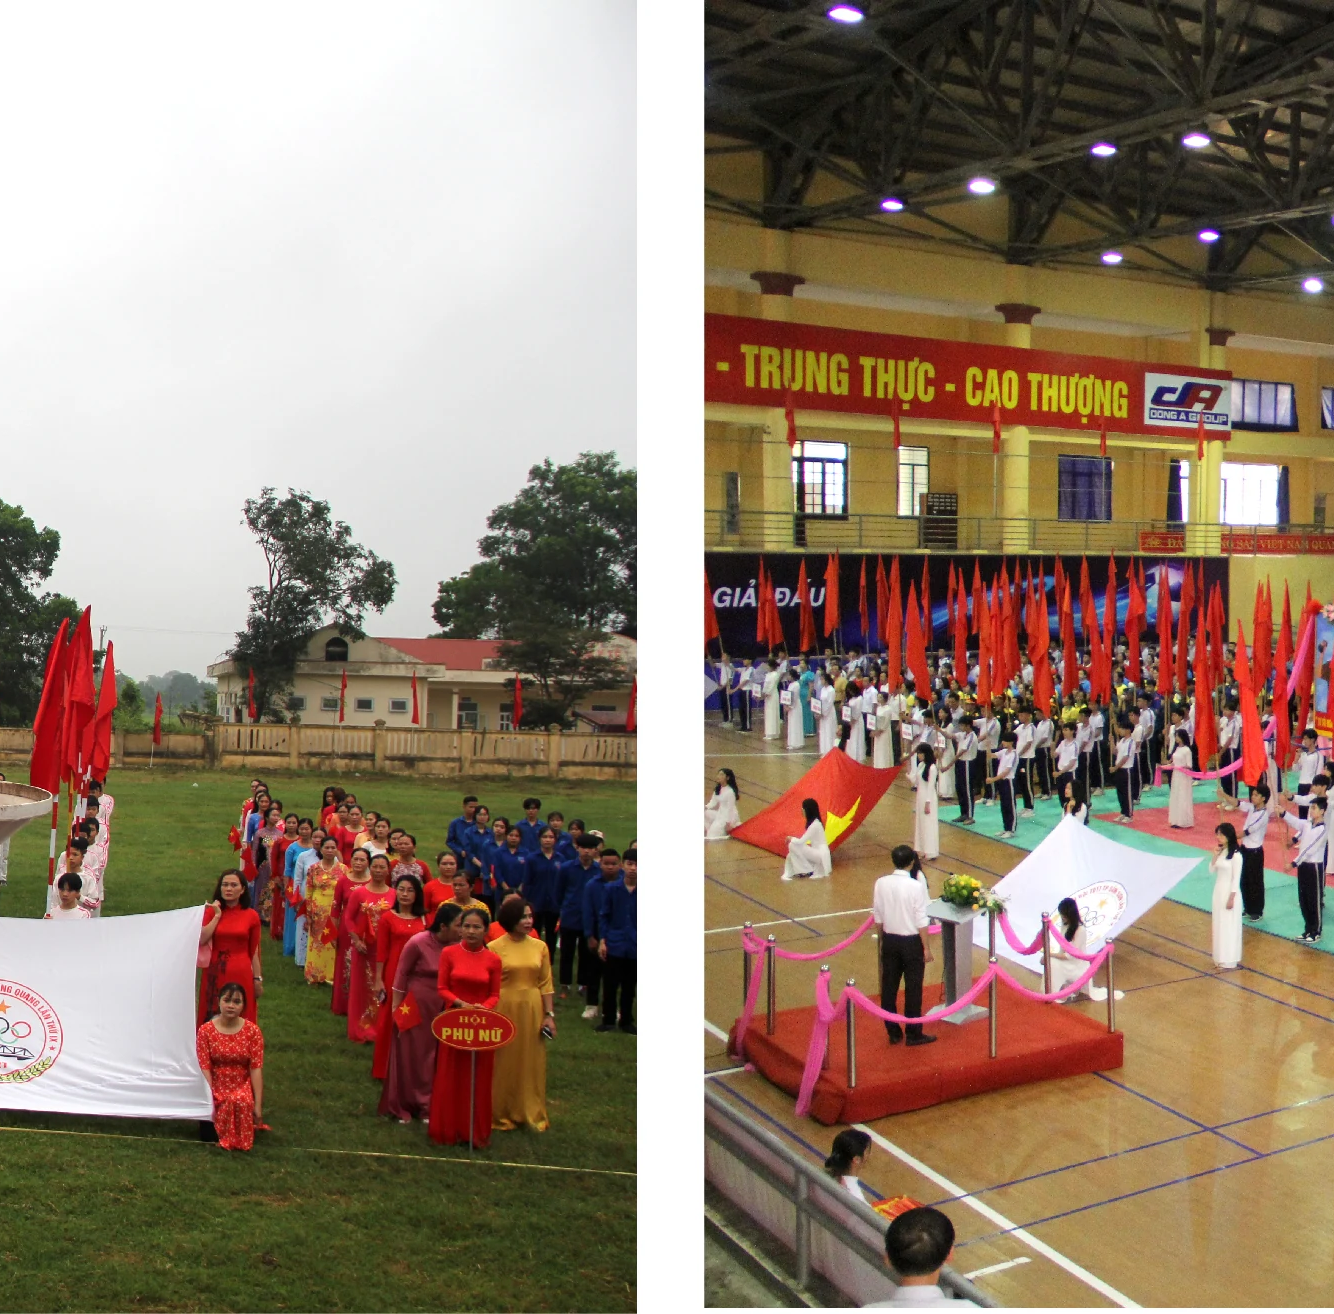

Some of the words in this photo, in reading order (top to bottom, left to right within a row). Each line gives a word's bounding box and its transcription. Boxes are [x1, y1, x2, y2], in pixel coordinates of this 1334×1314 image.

[740, 344, 849, 395] TRUNG
[859, 356, 935, 410] THỰC
[965, 366, 1018, 409] CAO
[1027, 372, 1129, 424] THƯỢNG
[1150, 410, 1178, 421] DONG
[1179, 411, 1187, 422] A
[713, 579, 758, 607] GIẢ
[14, 988, 41, 1007] QUANG
[459, 1014, 486, 1025] HỘI
[442, 1027, 474, 1044] PHỤ
[479, 1027, 503, 1042] NỮ
